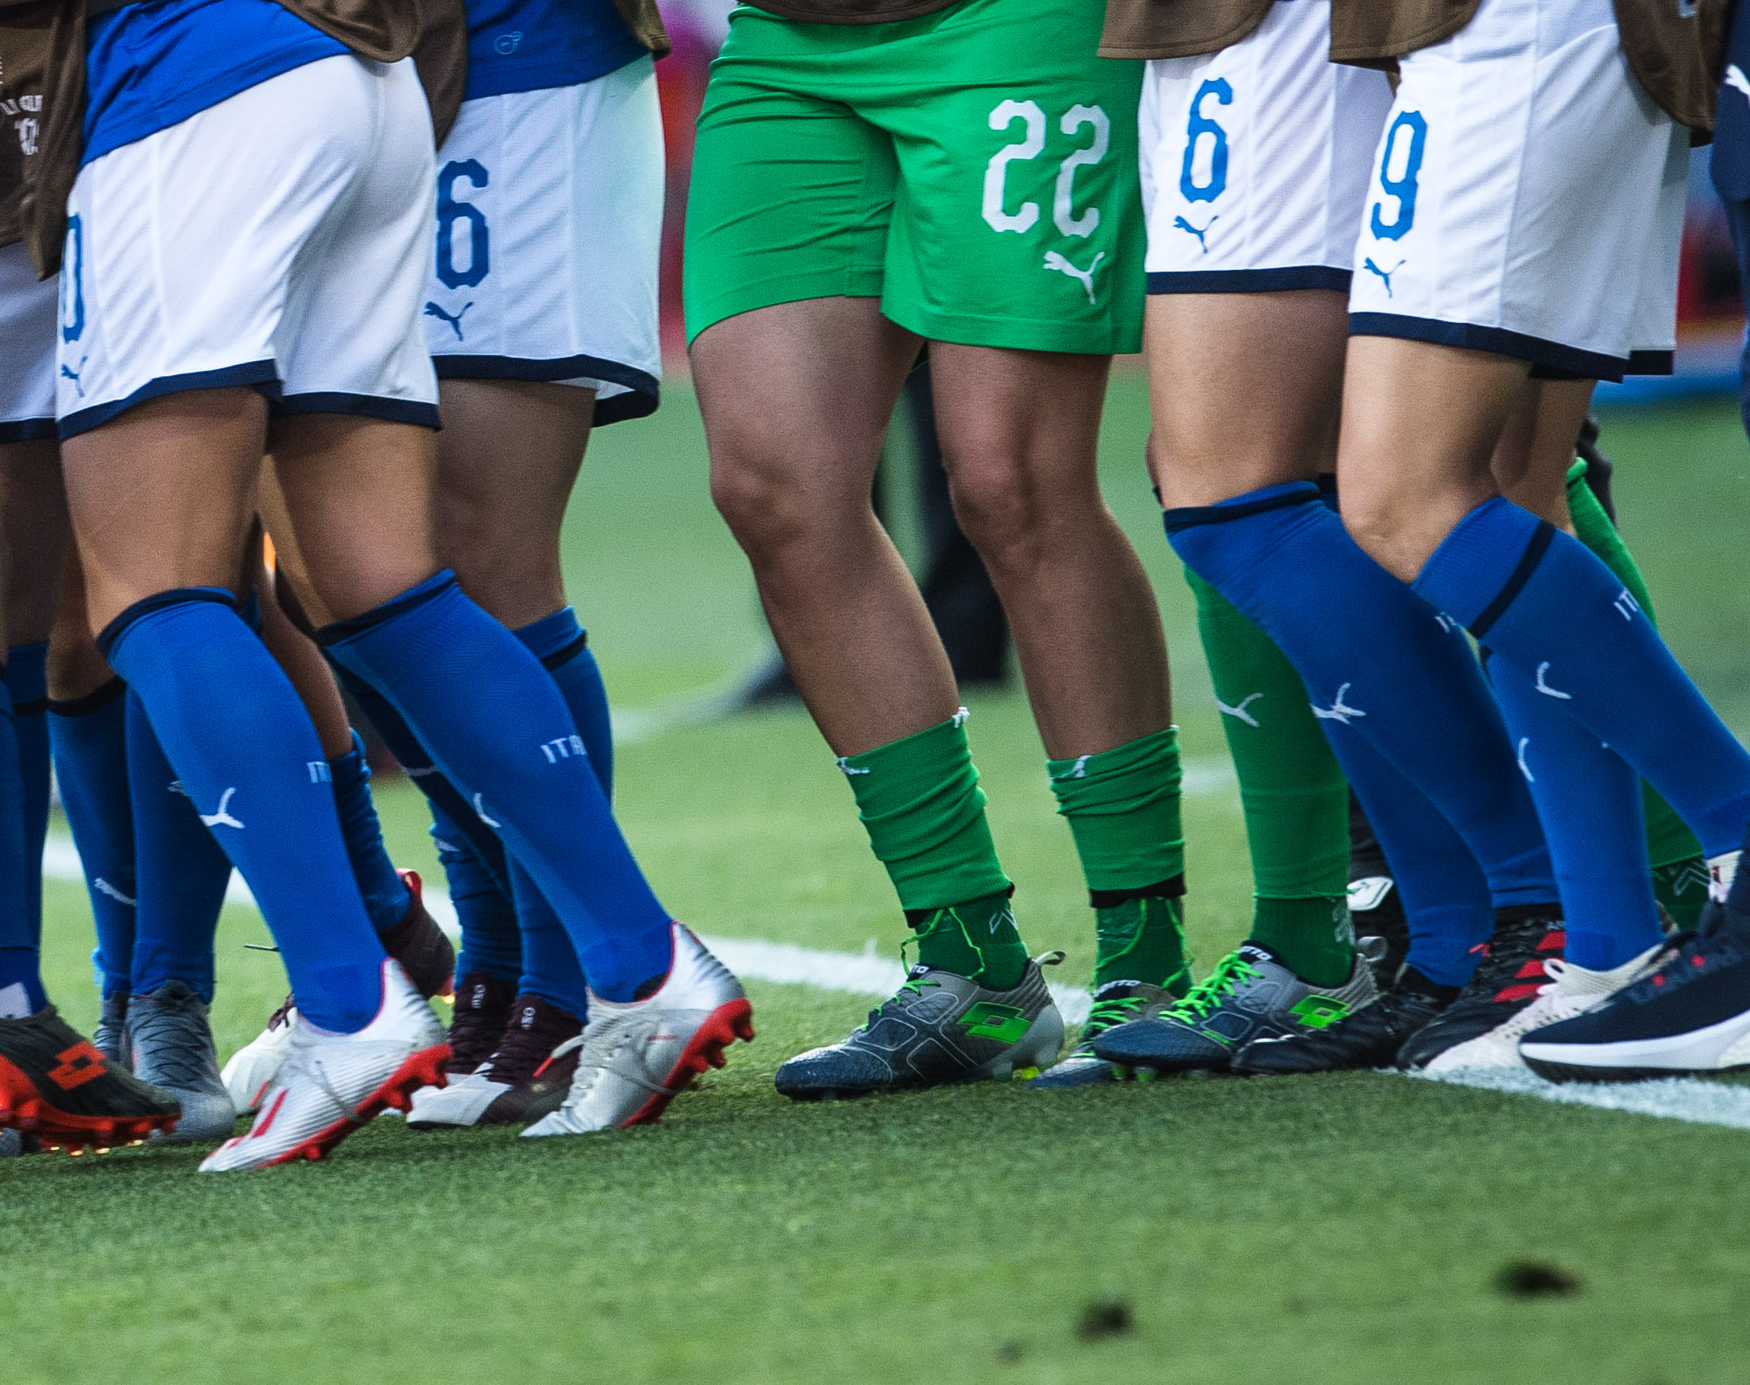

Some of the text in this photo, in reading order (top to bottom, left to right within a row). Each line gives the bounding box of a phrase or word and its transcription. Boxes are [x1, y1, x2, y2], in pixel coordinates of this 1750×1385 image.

[981, 99, 1111, 239] 22
[1179, 76, 1233, 204] 6
[1370, 110, 1429, 242] 9
[436, 158, 490, 290] 6
